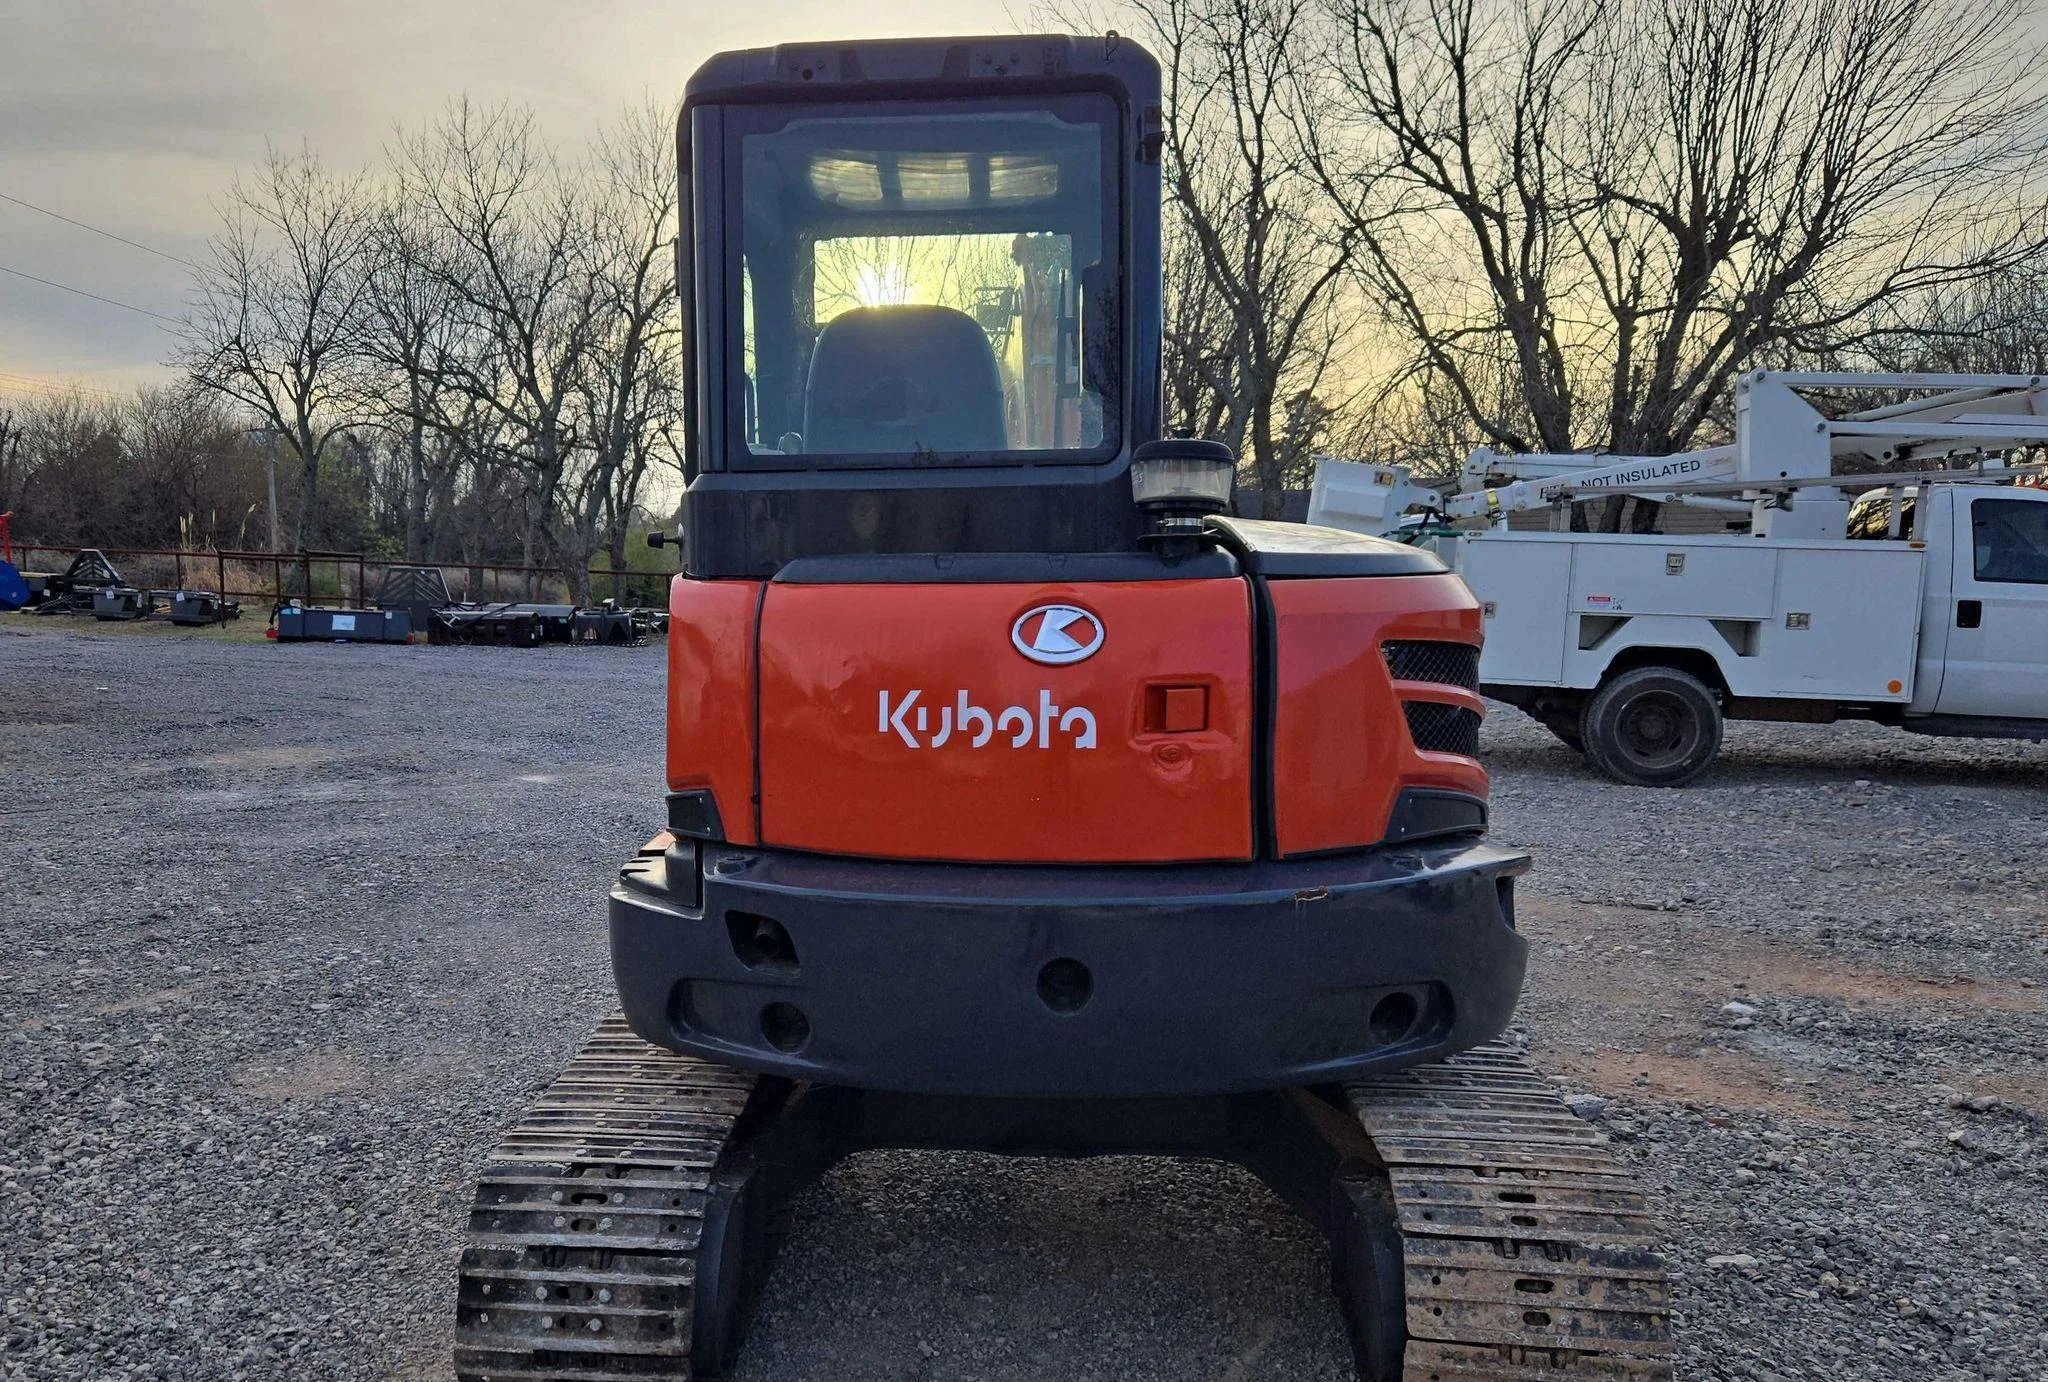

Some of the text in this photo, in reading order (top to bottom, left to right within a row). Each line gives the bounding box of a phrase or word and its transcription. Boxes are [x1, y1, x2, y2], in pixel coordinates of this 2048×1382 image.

[1581, 475, 1612, 487] NOT
[1616, 460, 1700, 484] INSULATED
[878, 689, 1097, 749] Kubota
